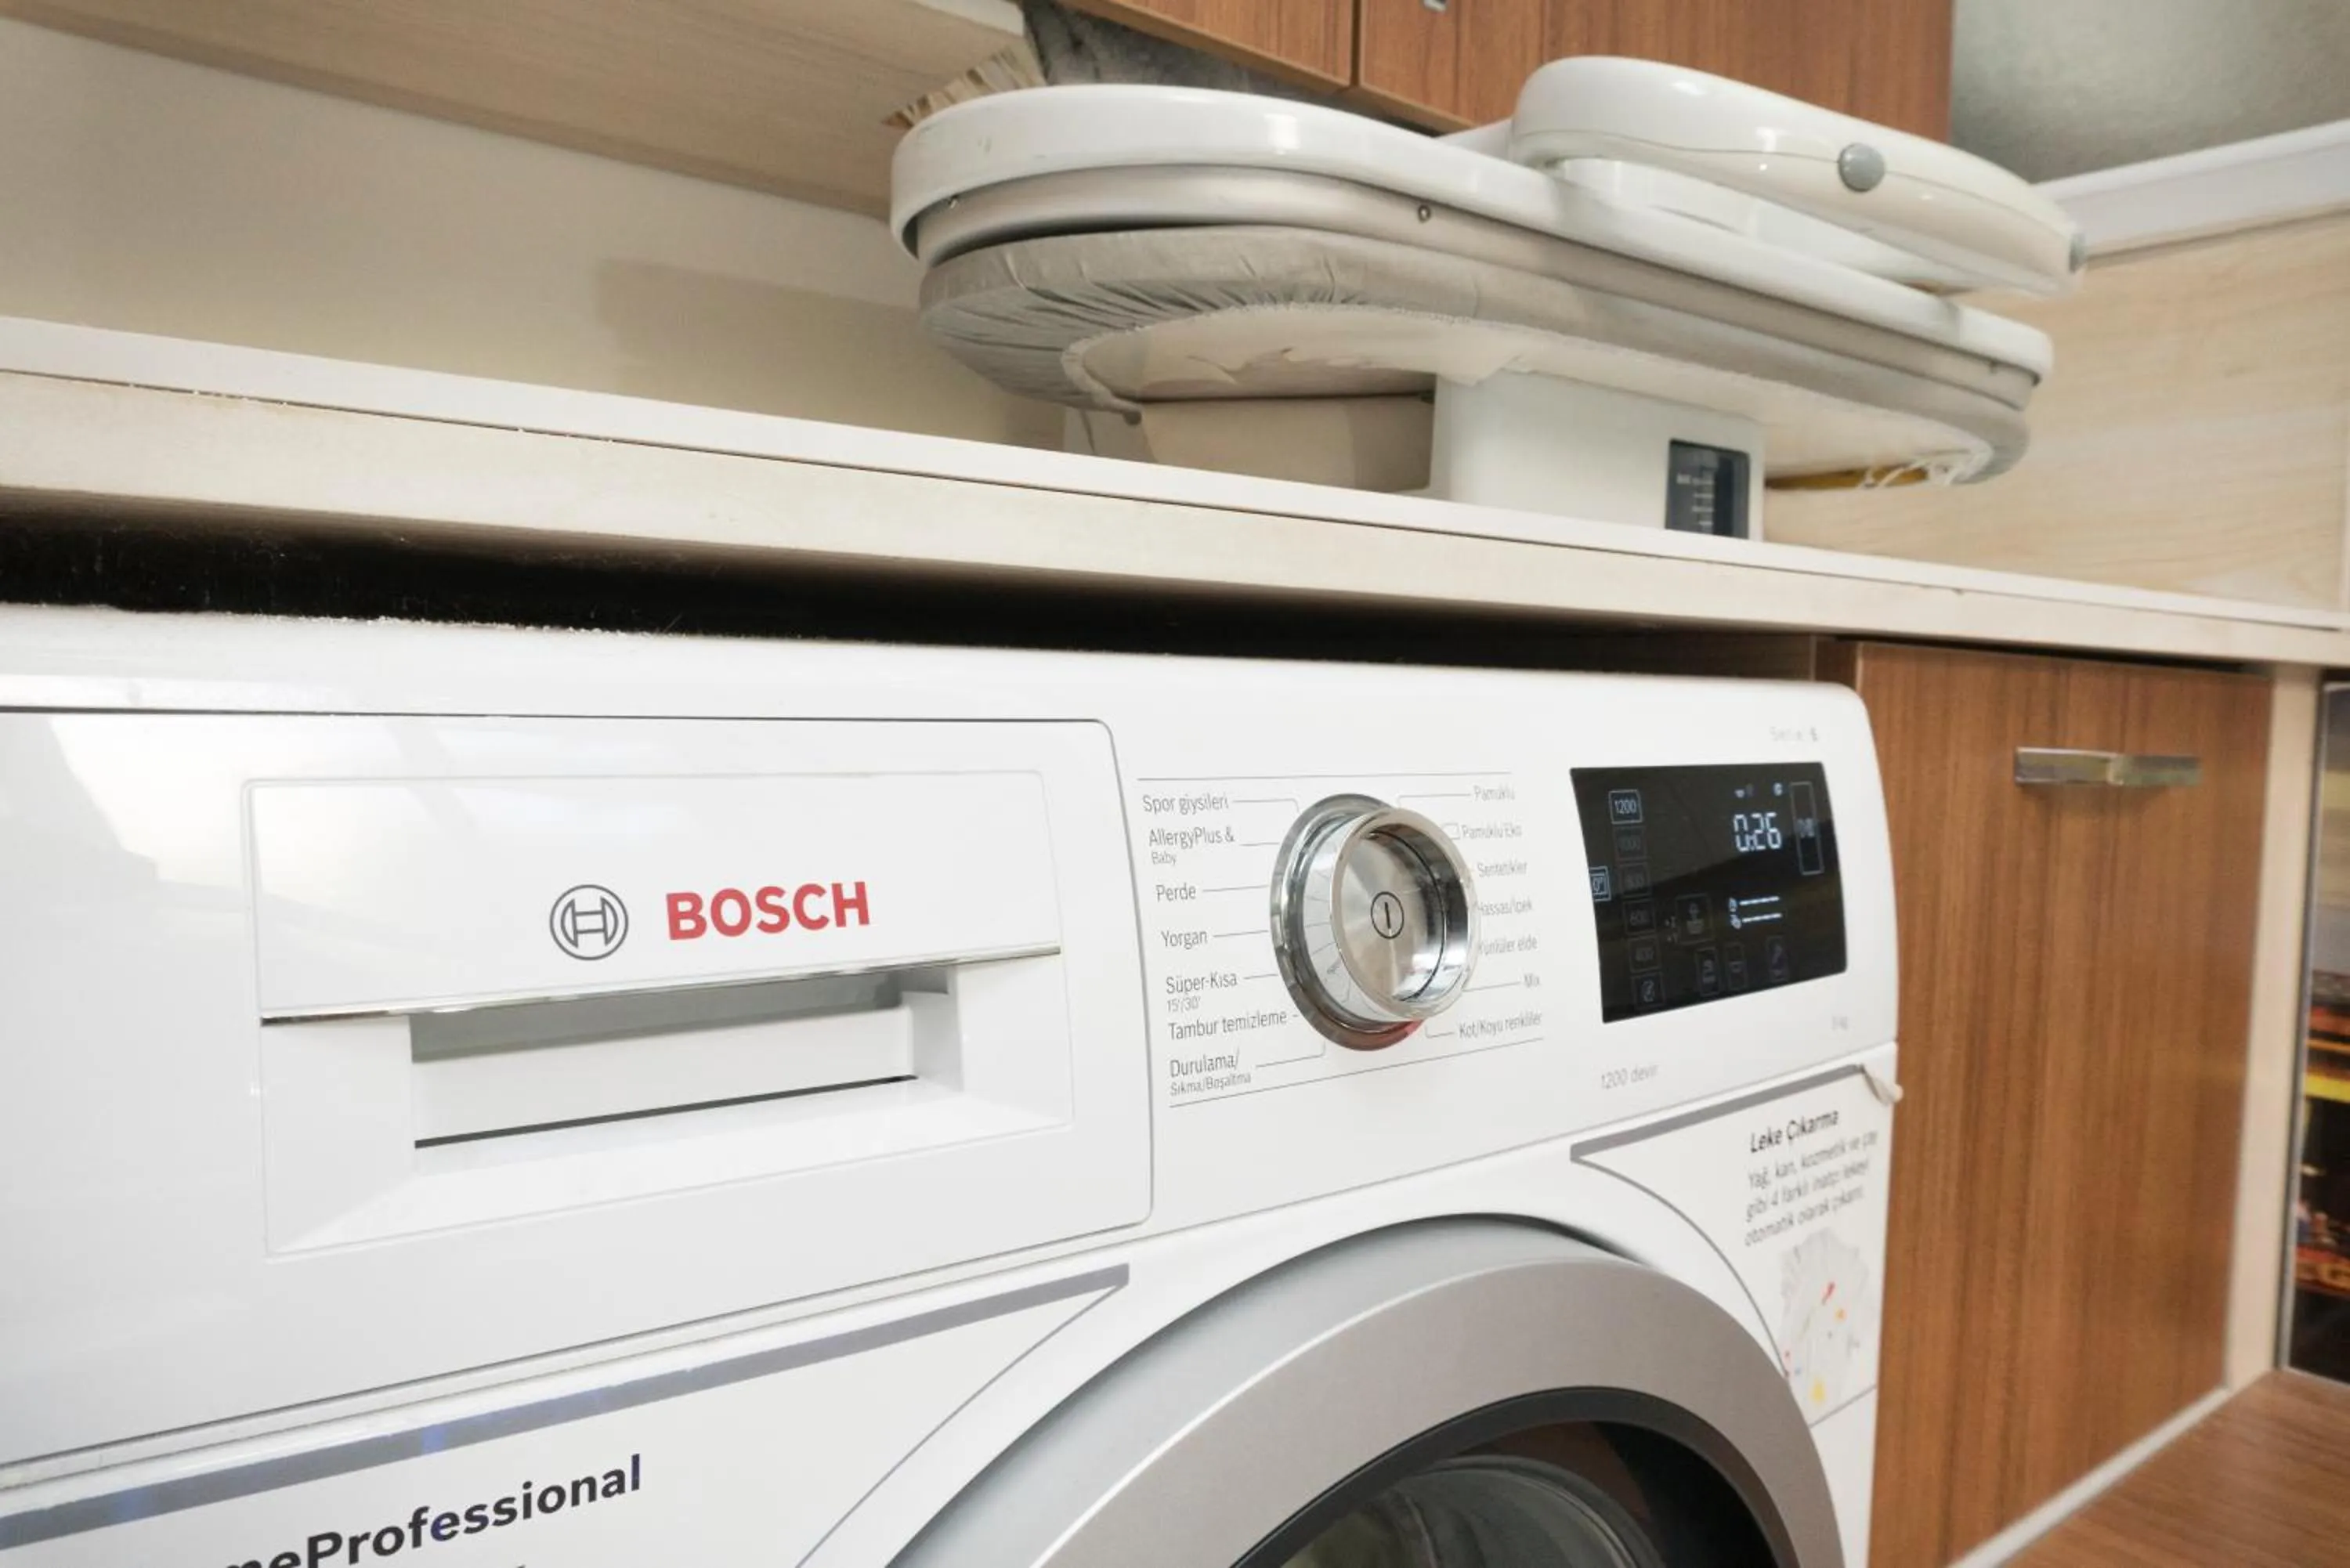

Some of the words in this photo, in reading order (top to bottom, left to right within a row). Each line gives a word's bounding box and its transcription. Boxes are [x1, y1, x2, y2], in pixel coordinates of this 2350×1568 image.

[1142, 794, 1176, 815] Spor
[1179, 792, 1229, 815] giysileri
[1614, 798, 1637, 814] 1200
[1149, 826, 1222, 850] AllergyPlus
[1224, 826, 1235, 843] &
[1151, 850, 1177, 865] Baby
[1155, 882, 1196, 902] Perde
[666, 881, 870, 940] BOSCH
[1161, 930, 1208, 950] Yorgan
[1165, 970, 1238, 995] Süper-Kısa
[1168, 1018, 1218, 1040] Tambur
[1222, 1010, 1288, 1033] temizleme
[1170, 1046, 1241, 1078] Durulama/
[1750, 1127, 1783, 1153] Leke
[226, 1454, 641, 1568] eProfessional
